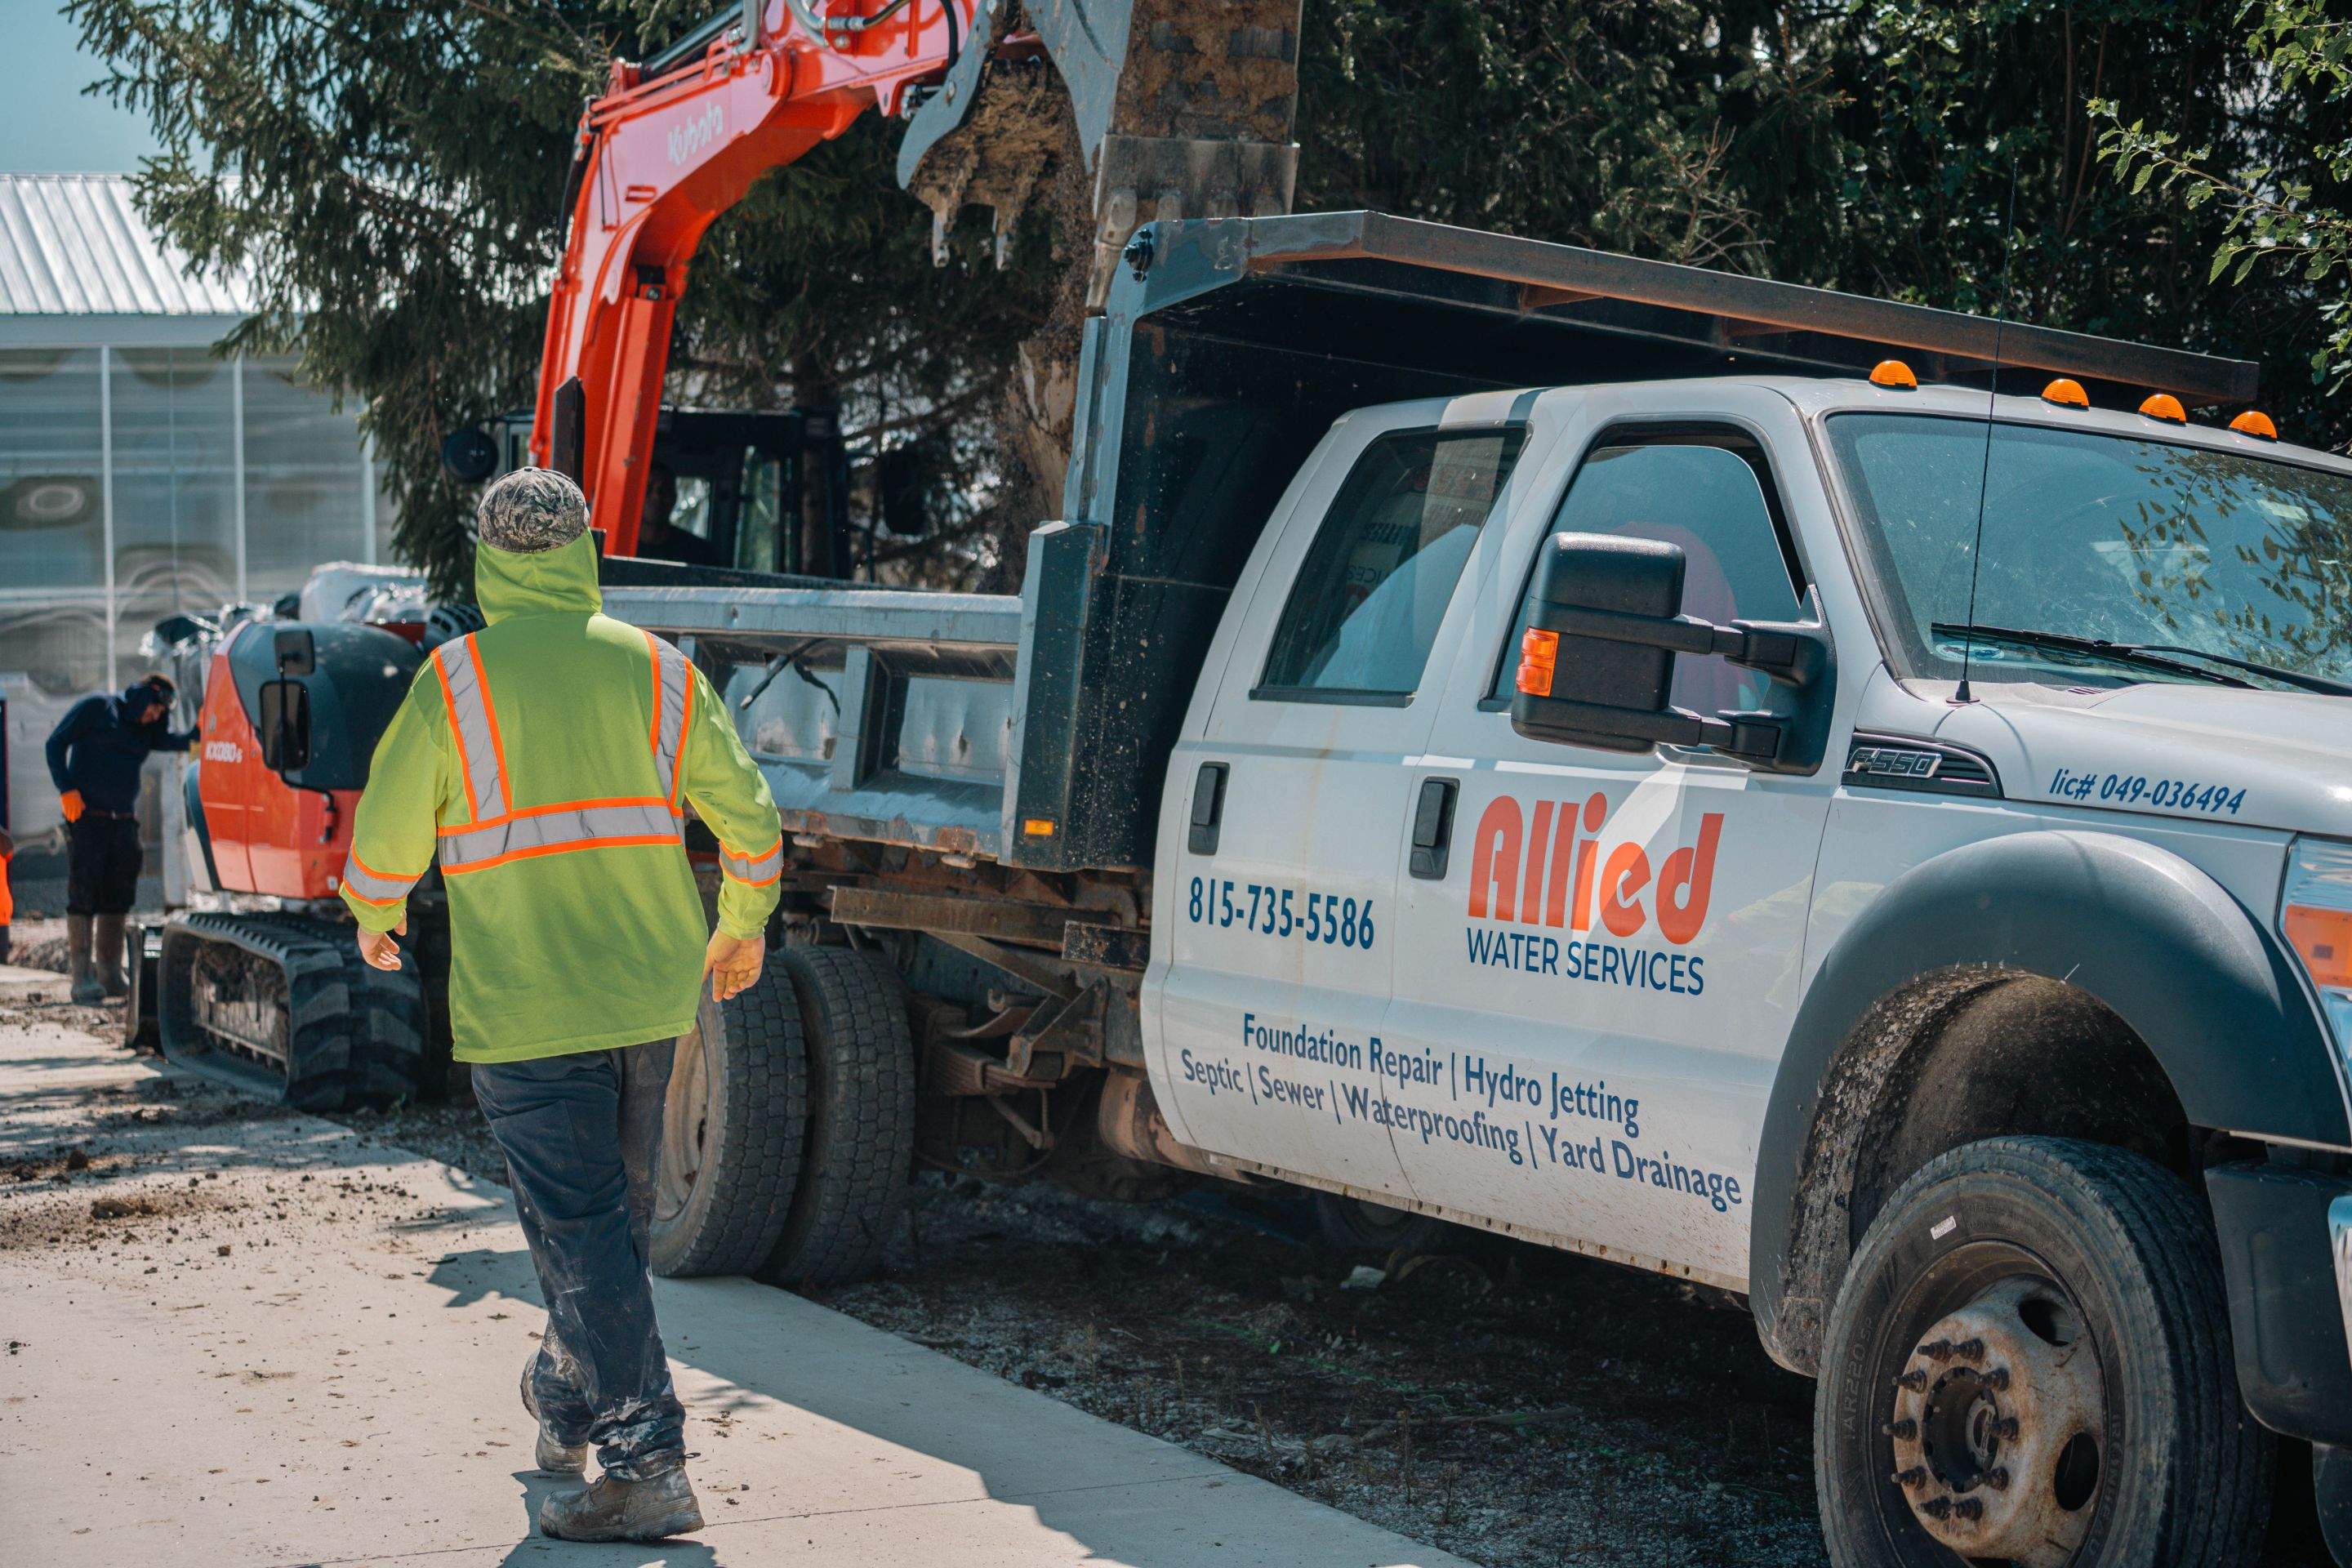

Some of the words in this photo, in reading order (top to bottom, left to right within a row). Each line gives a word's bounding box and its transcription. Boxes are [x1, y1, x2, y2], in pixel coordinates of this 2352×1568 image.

[2047, 768, 2098, 800] lic#
[2100, 773, 2247, 816] 049-036494
[1188, 875, 1375, 951] 815-735-5586
[1468, 791, 1725, 946] Allied
[1466, 927, 1559, 976] WATER
[1566, 941, 1705, 996] SERVICES
[1244, 1013, 1361, 1068] Foundation
[1370, 1036, 1443, 1087] Repair
[1465, 1054, 1543, 1109] Hydro
[1549, 1071, 1641, 1138] Jetting
[1181, 1049, 1245, 1098] Septic
[1258, 1065, 1325, 1112] Sewer
[1343, 1084, 1524, 1166] Waterproofing
[1539, 1124, 1606, 1174] Yard
[1611, 1138, 1743, 1213] Drainage
